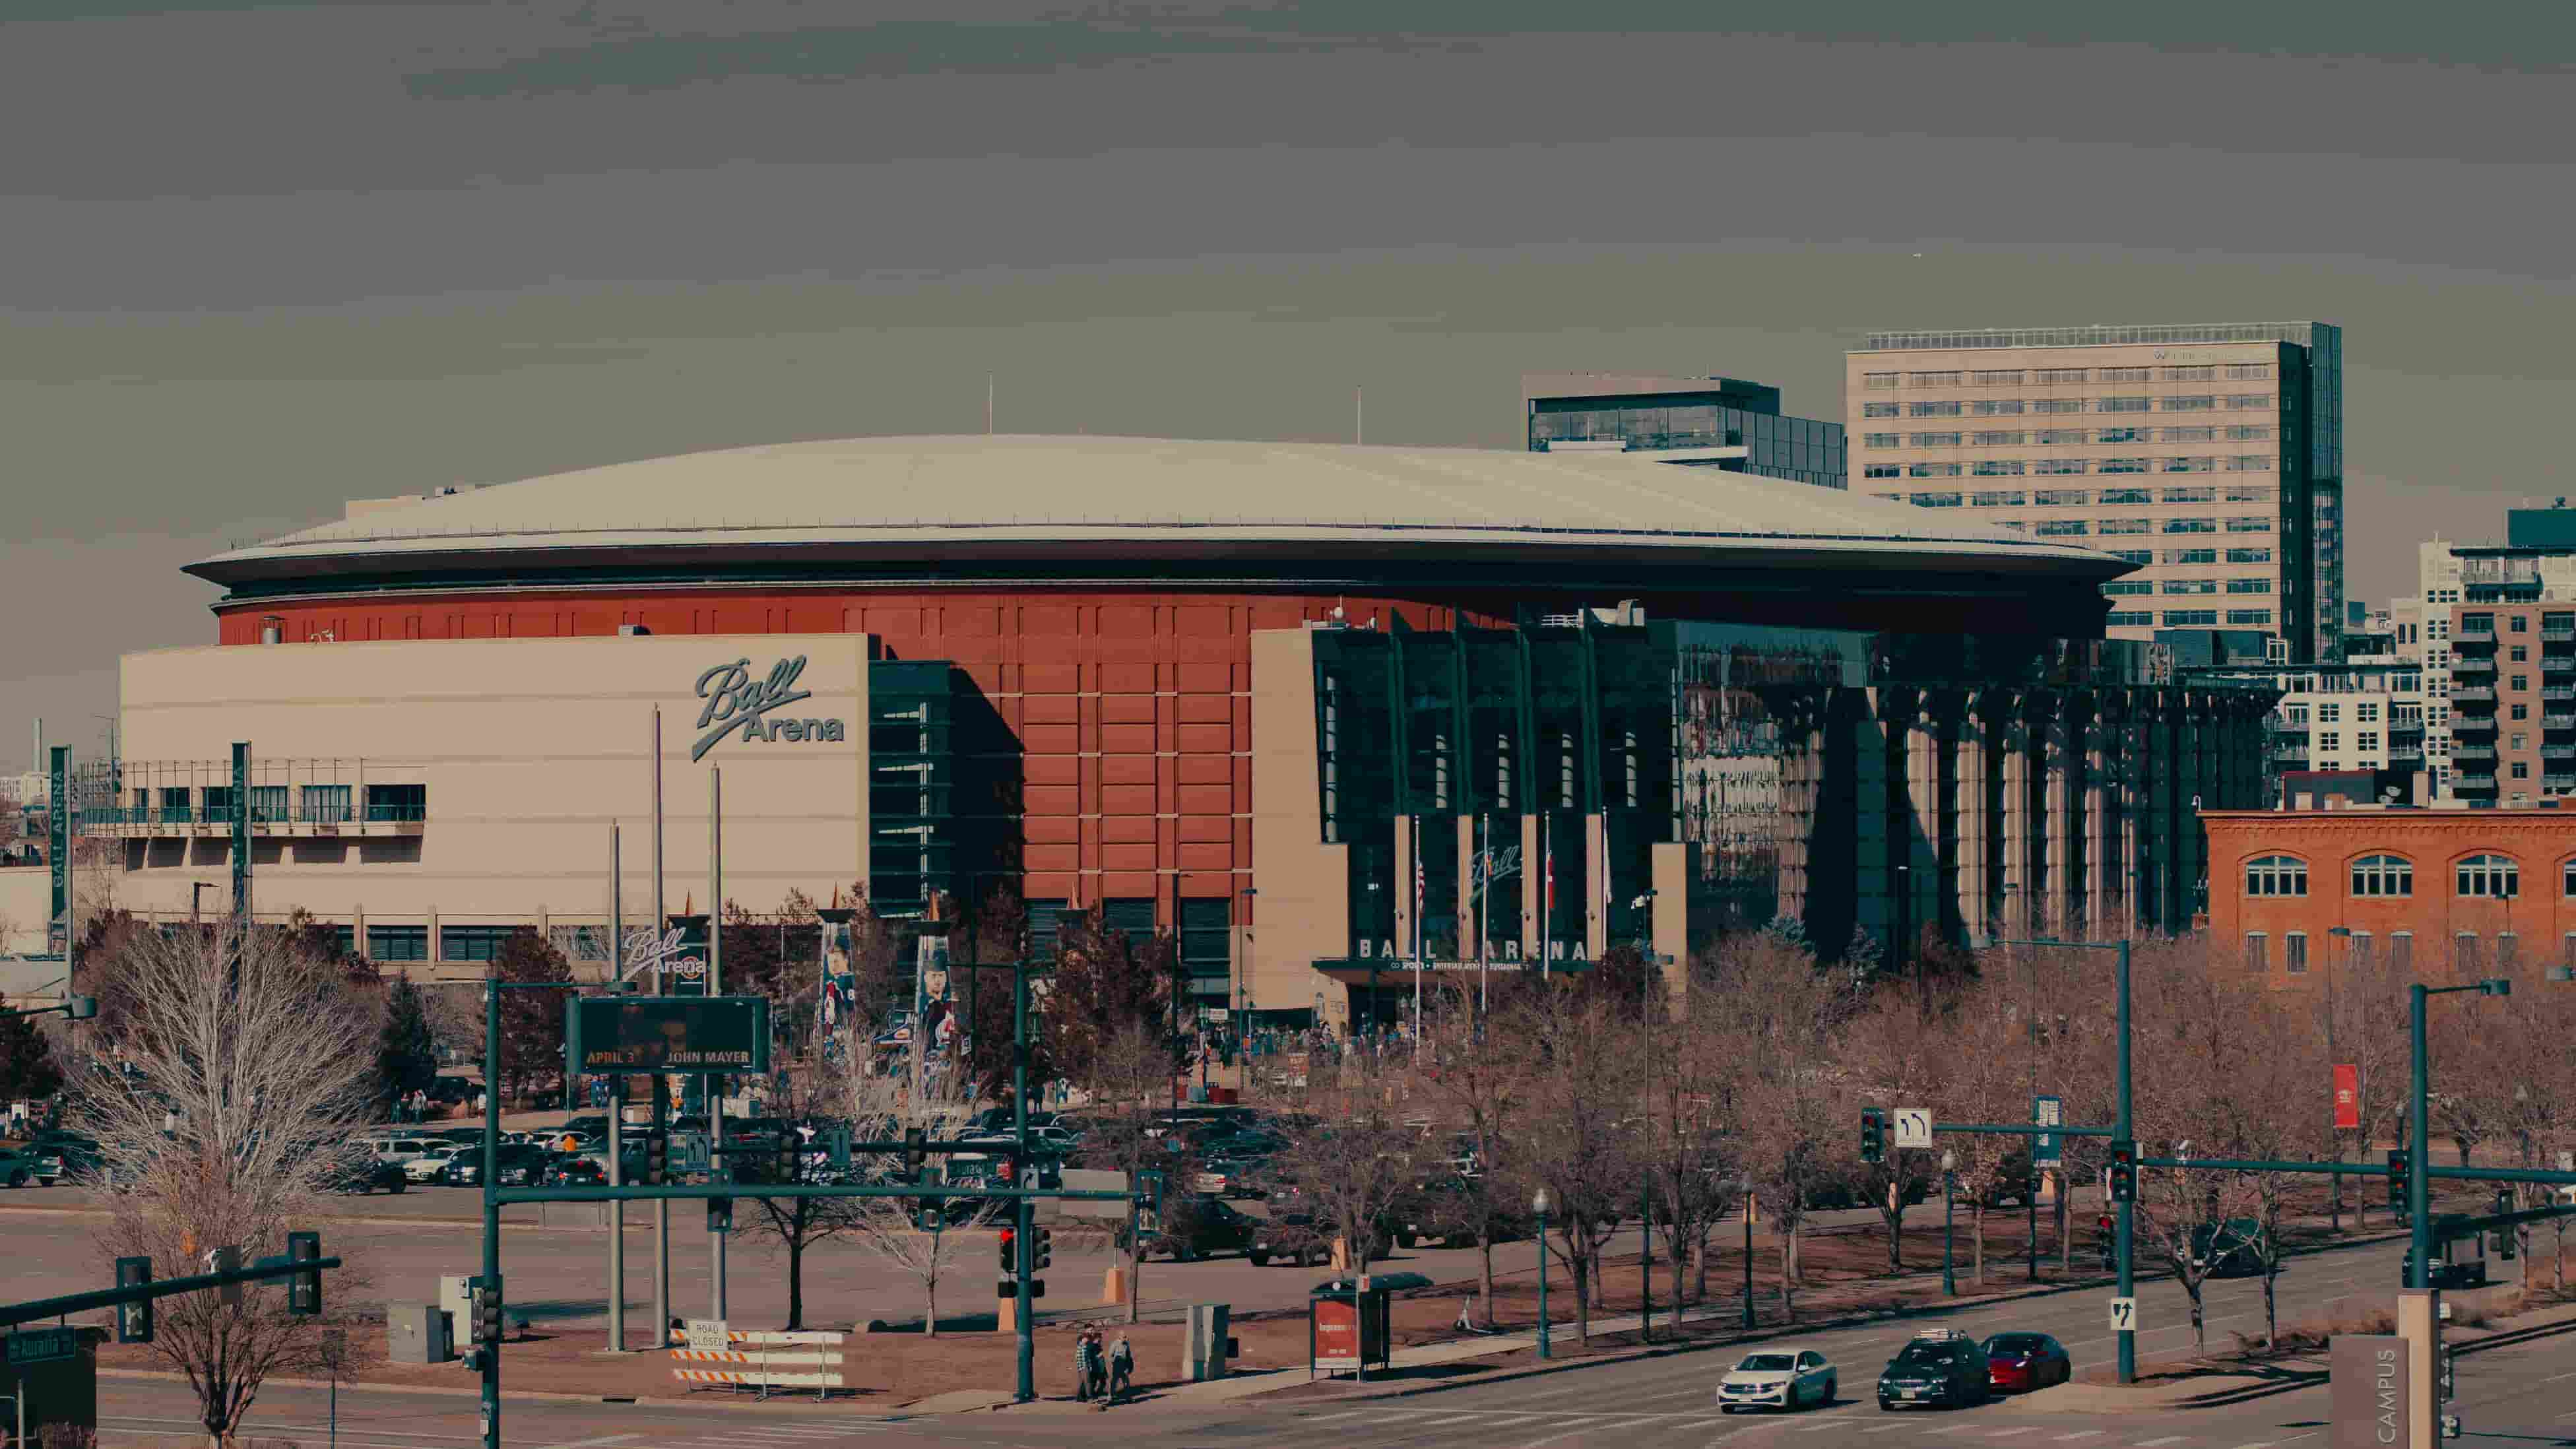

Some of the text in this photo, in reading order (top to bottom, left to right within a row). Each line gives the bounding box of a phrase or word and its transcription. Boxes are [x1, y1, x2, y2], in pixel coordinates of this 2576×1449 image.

[692, 654, 811, 764] Ball
[742, 713, 845, 742] Arena
[52, 770, 64, 887] BALL ARENA
[622, 927, 688, 982] Ball
[1360, 939, 1436, 958] BALL
[651, 956, 707, 973] Arena
[587, 1050, 624, 1063] APRIL
[666, 1050, 701, 1063] JOHN
[705, 1050, 750, 1063] MAYER
[692, 1335, 724, 1347] CLOSED
[697, 1324, 719, 1334] ROAD
[2377, 1349, 2397, 1445] CAMPUS
